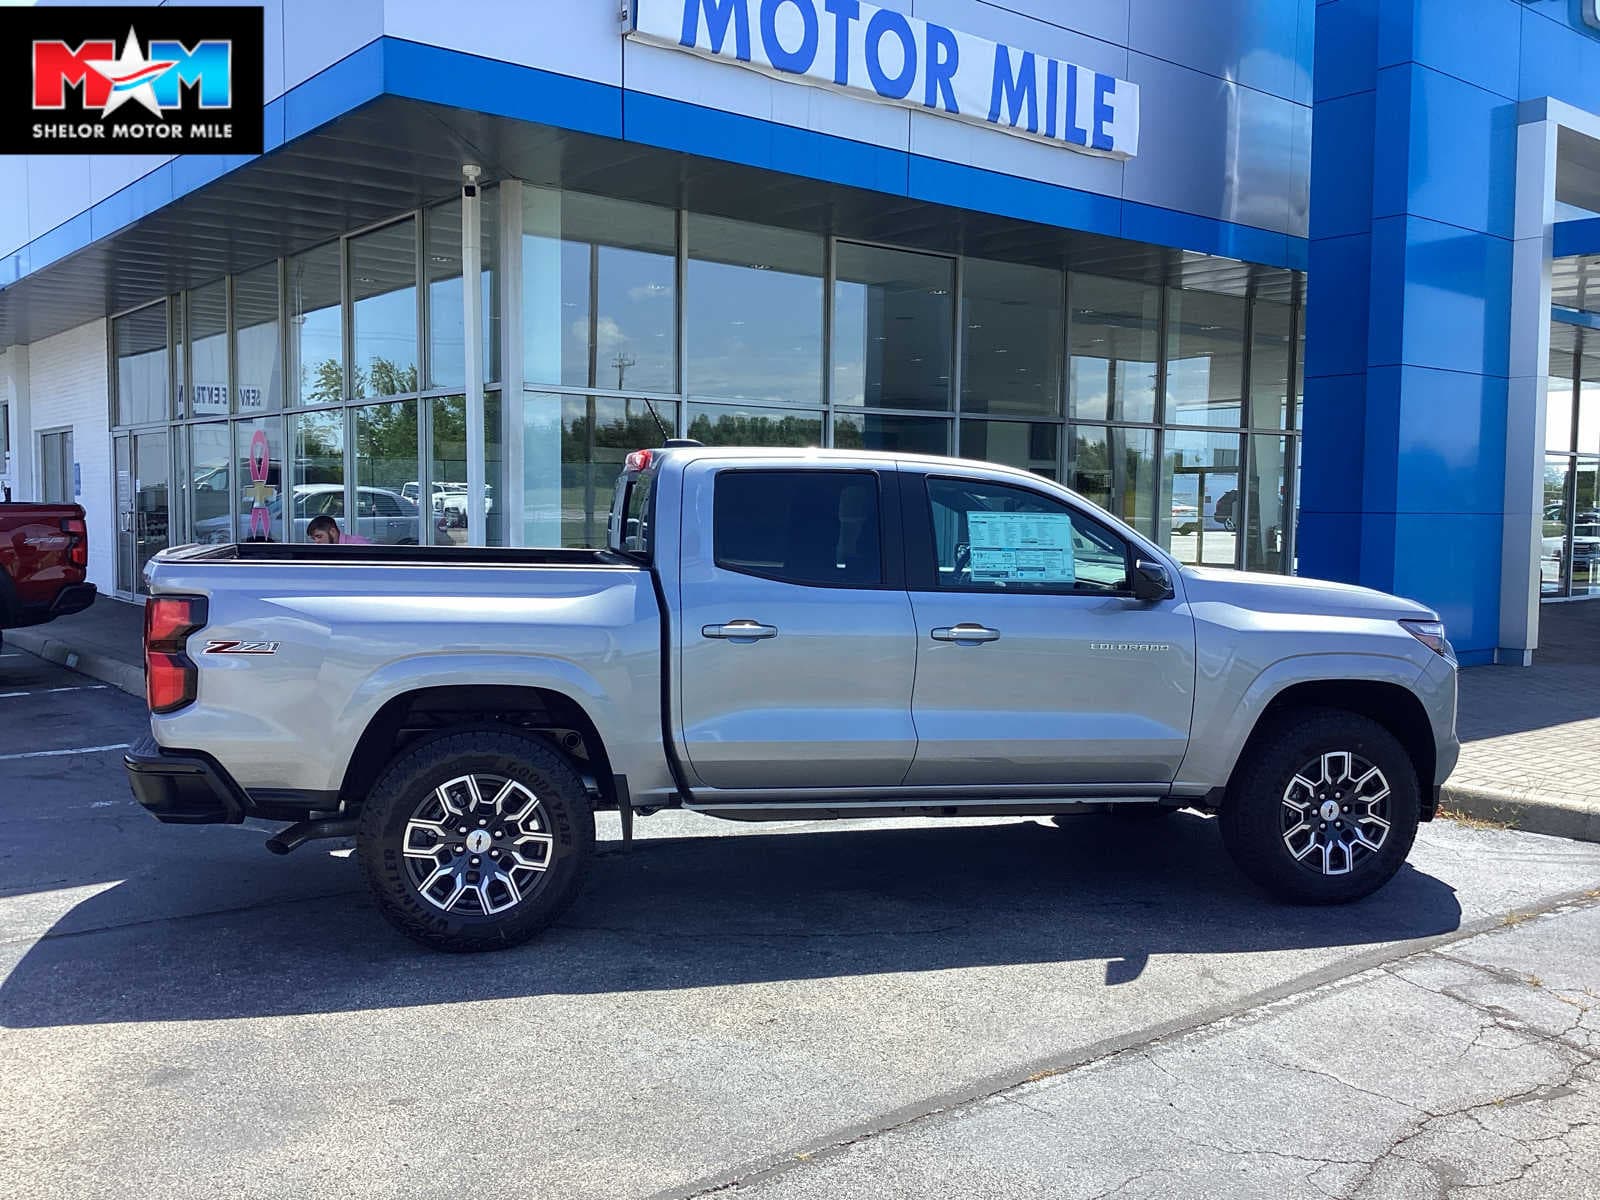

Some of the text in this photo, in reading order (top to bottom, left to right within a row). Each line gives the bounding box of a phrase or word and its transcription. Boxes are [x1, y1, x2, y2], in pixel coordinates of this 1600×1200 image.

[679, 0, 1116, 151] MOTOR MILE
[201, 640, 281, 656] Z71
[1089, 642, 1169, 652] COLORADO
